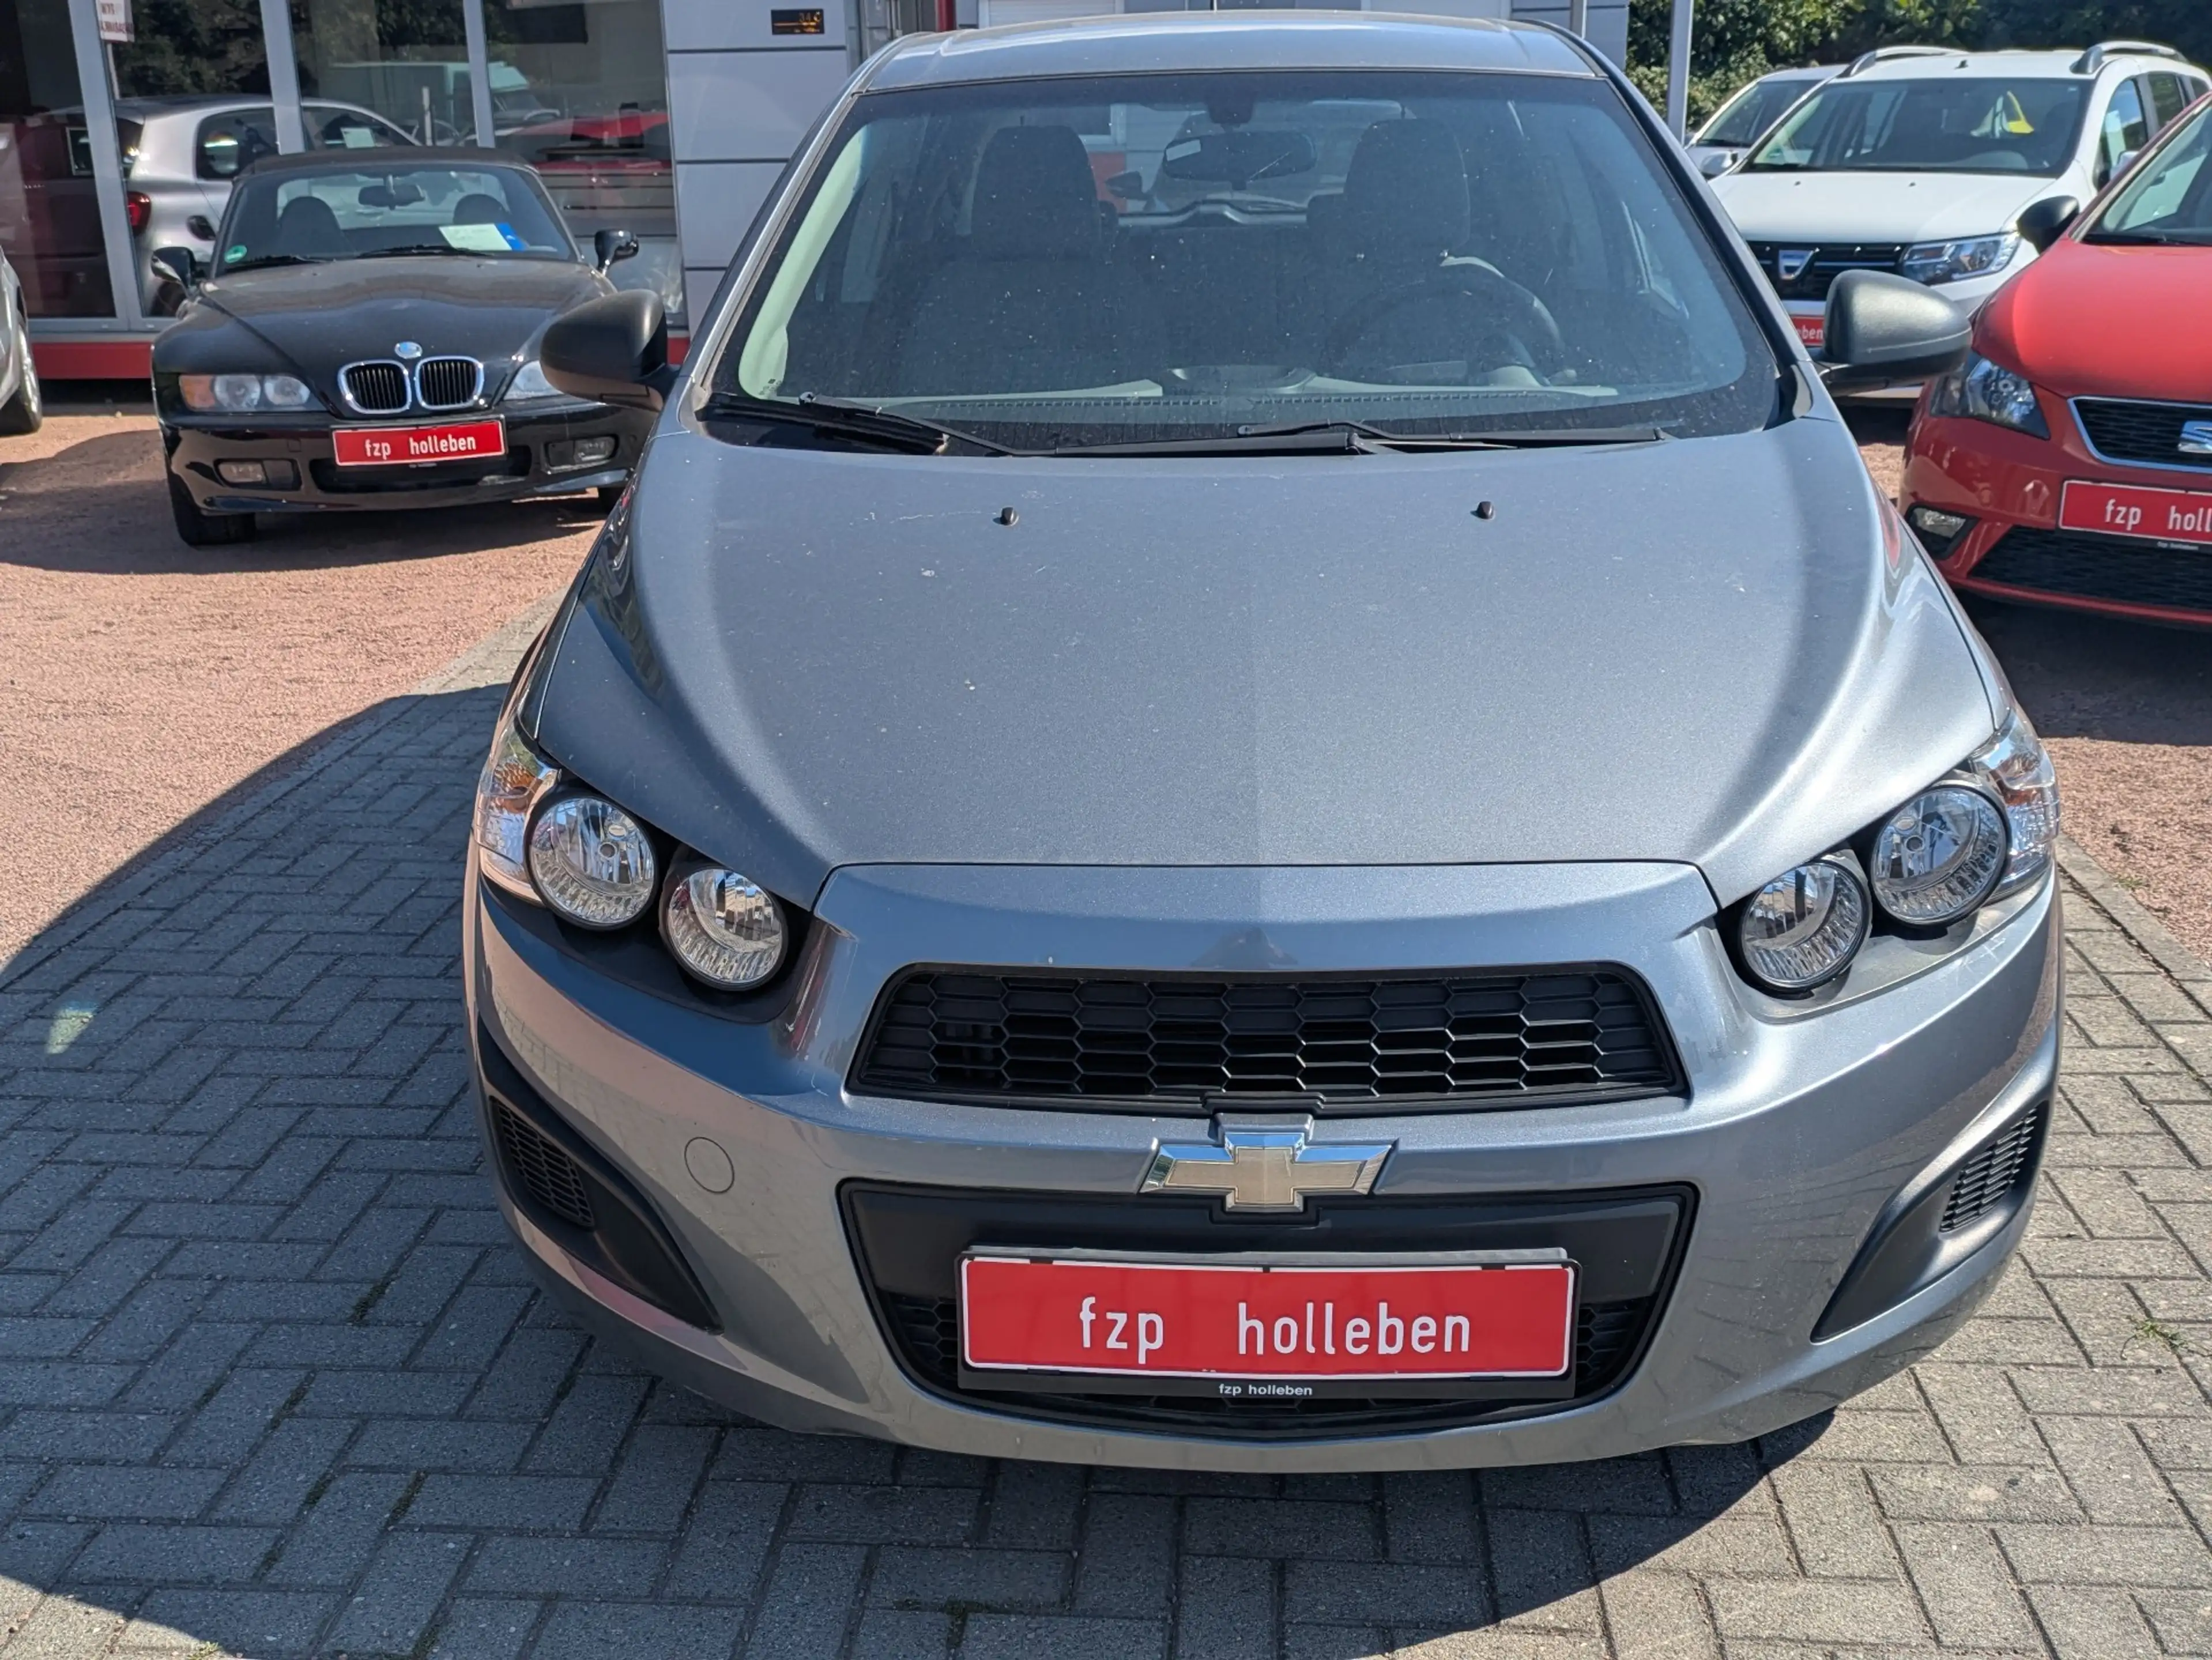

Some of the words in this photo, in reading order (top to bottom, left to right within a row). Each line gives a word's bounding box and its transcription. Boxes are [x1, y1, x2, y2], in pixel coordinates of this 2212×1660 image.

[364, 439, 391, 460] fzp
[409, 433, 476, 455] holleben
[2105, 499, 2142, 531] fzp
[1080, 1296, 1164, 1364] fzp
[1238, 1302, 1470, 1355] holleben
[1219, 1383, 1242, 1396] fzp
[1248, 1384, 1313, 1395] holleben
